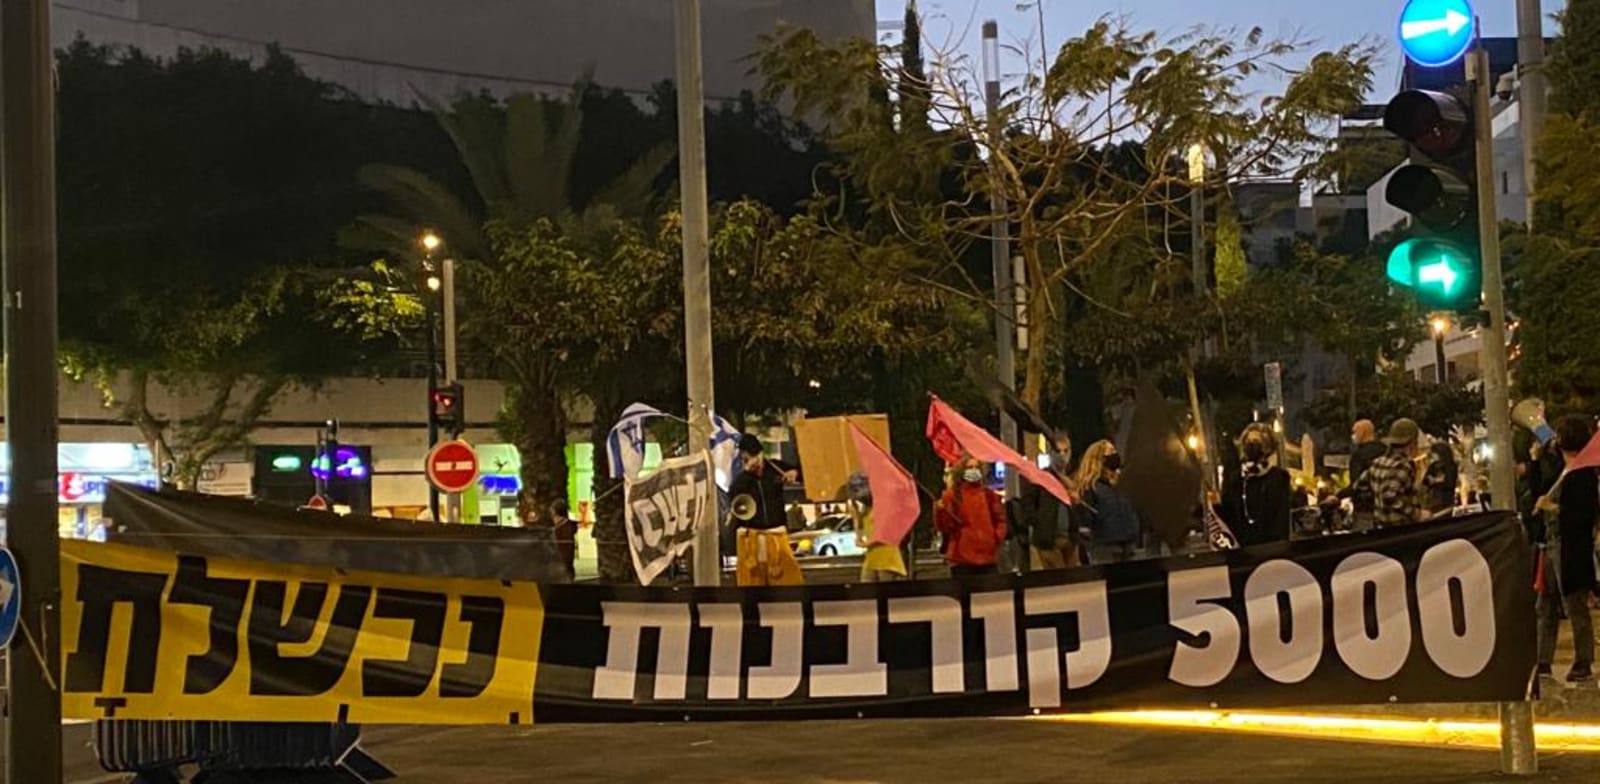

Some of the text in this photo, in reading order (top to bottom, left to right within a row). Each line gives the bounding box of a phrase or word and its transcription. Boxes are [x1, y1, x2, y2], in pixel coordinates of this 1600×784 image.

[65, 538, 1496, 708] 5000 קורבנות נכשלת
